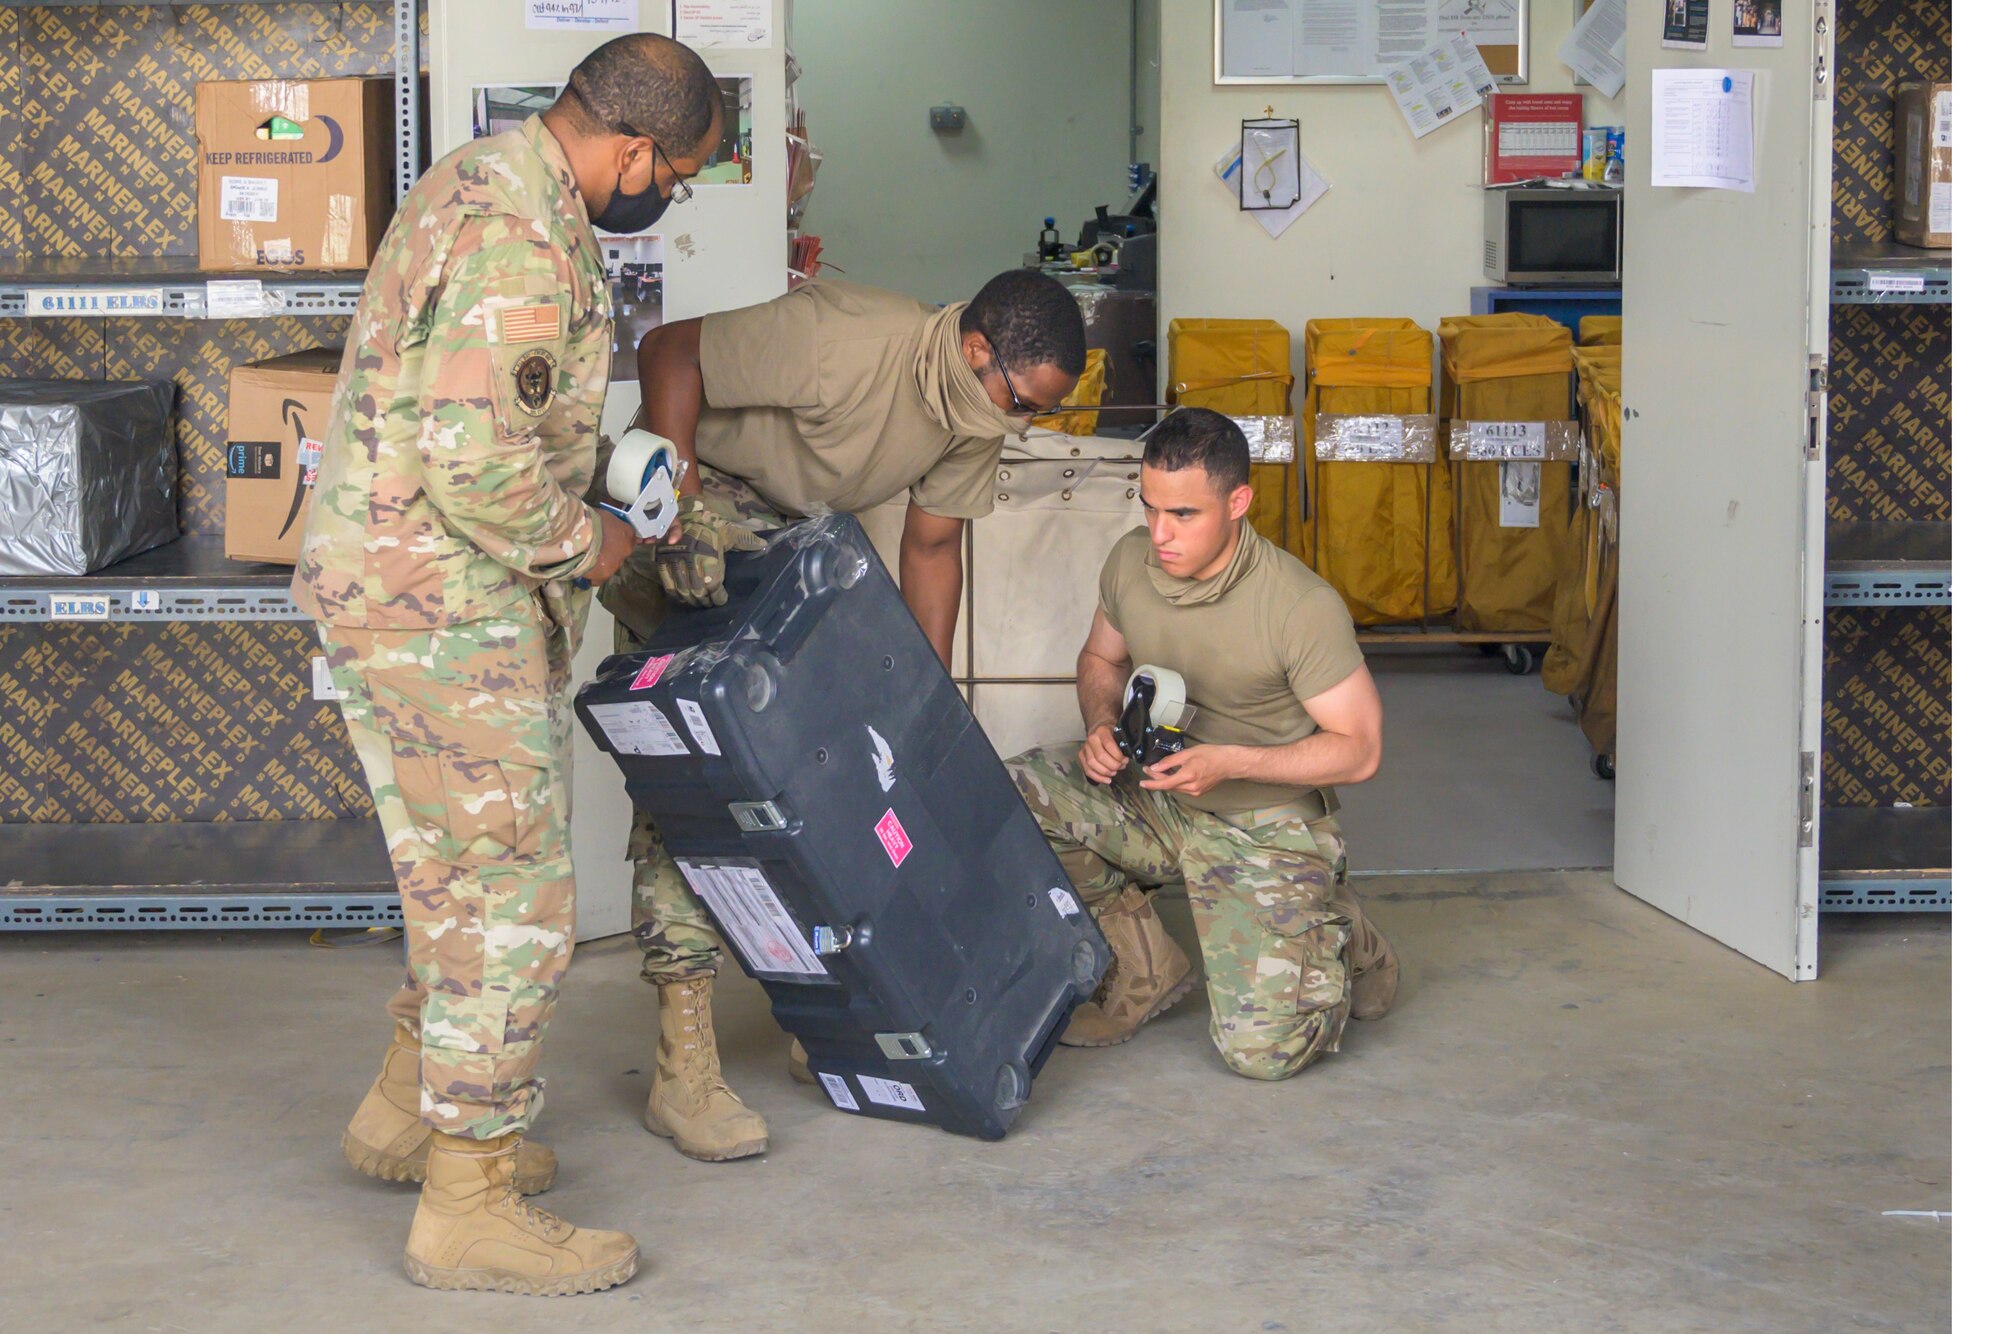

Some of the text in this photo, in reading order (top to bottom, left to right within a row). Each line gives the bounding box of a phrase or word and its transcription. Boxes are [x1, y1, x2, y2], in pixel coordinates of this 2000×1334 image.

[58, 134, 177, 250] MARINEPLEX
[84, 107, 197, 224] MARINEPLEX
[206, 151, 312, 165] KEEP REFRIGERATED
[43, 295, 158, 310] 61111 ELRS
[236, 445, 247, 474] prime
[1486, 425, 1527, 437] 61113
[54, 601, 106, 616] ELRS
[143, 642, 259, 755] MARINEPLEX
[167, 621, 285, 729] MARINEPLEX
[91, 694, 208, 807] MARINEPLEX
[116, 668, 233, 782] MARINEPLEX
[887, 820, 906, 849] CAUTION
